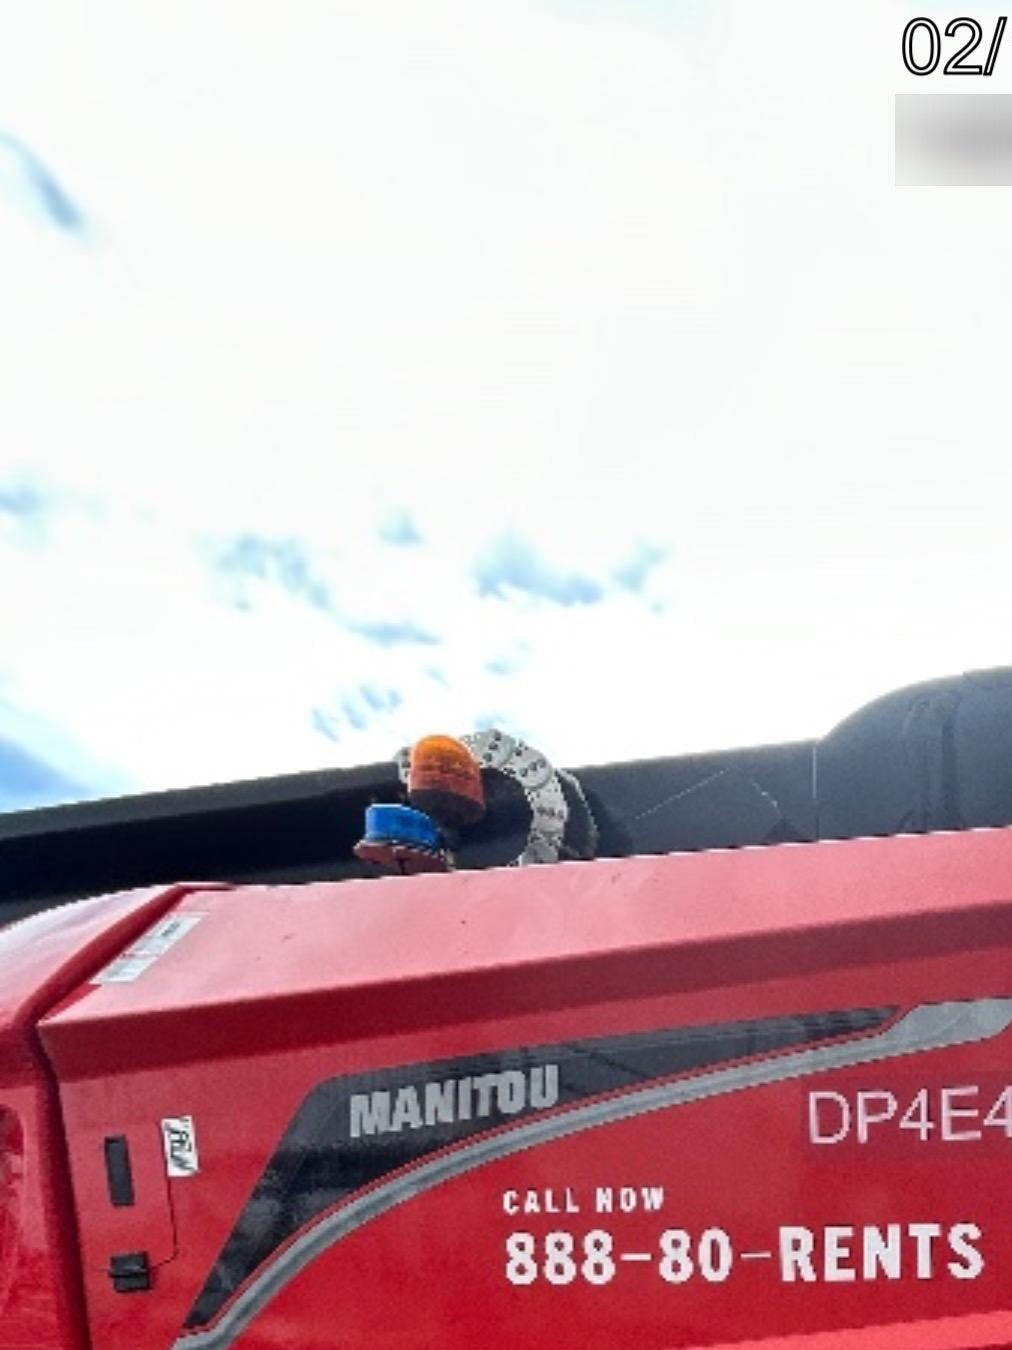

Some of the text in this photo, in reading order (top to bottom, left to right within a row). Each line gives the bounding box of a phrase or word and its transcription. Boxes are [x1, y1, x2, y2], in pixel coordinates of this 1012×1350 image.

[350, 1063, 560, 1138] MANITOU
[502, 1185, 665, 1216] CALL NOW
[505, 1221, 986, 1286] 888-80-RENTS
